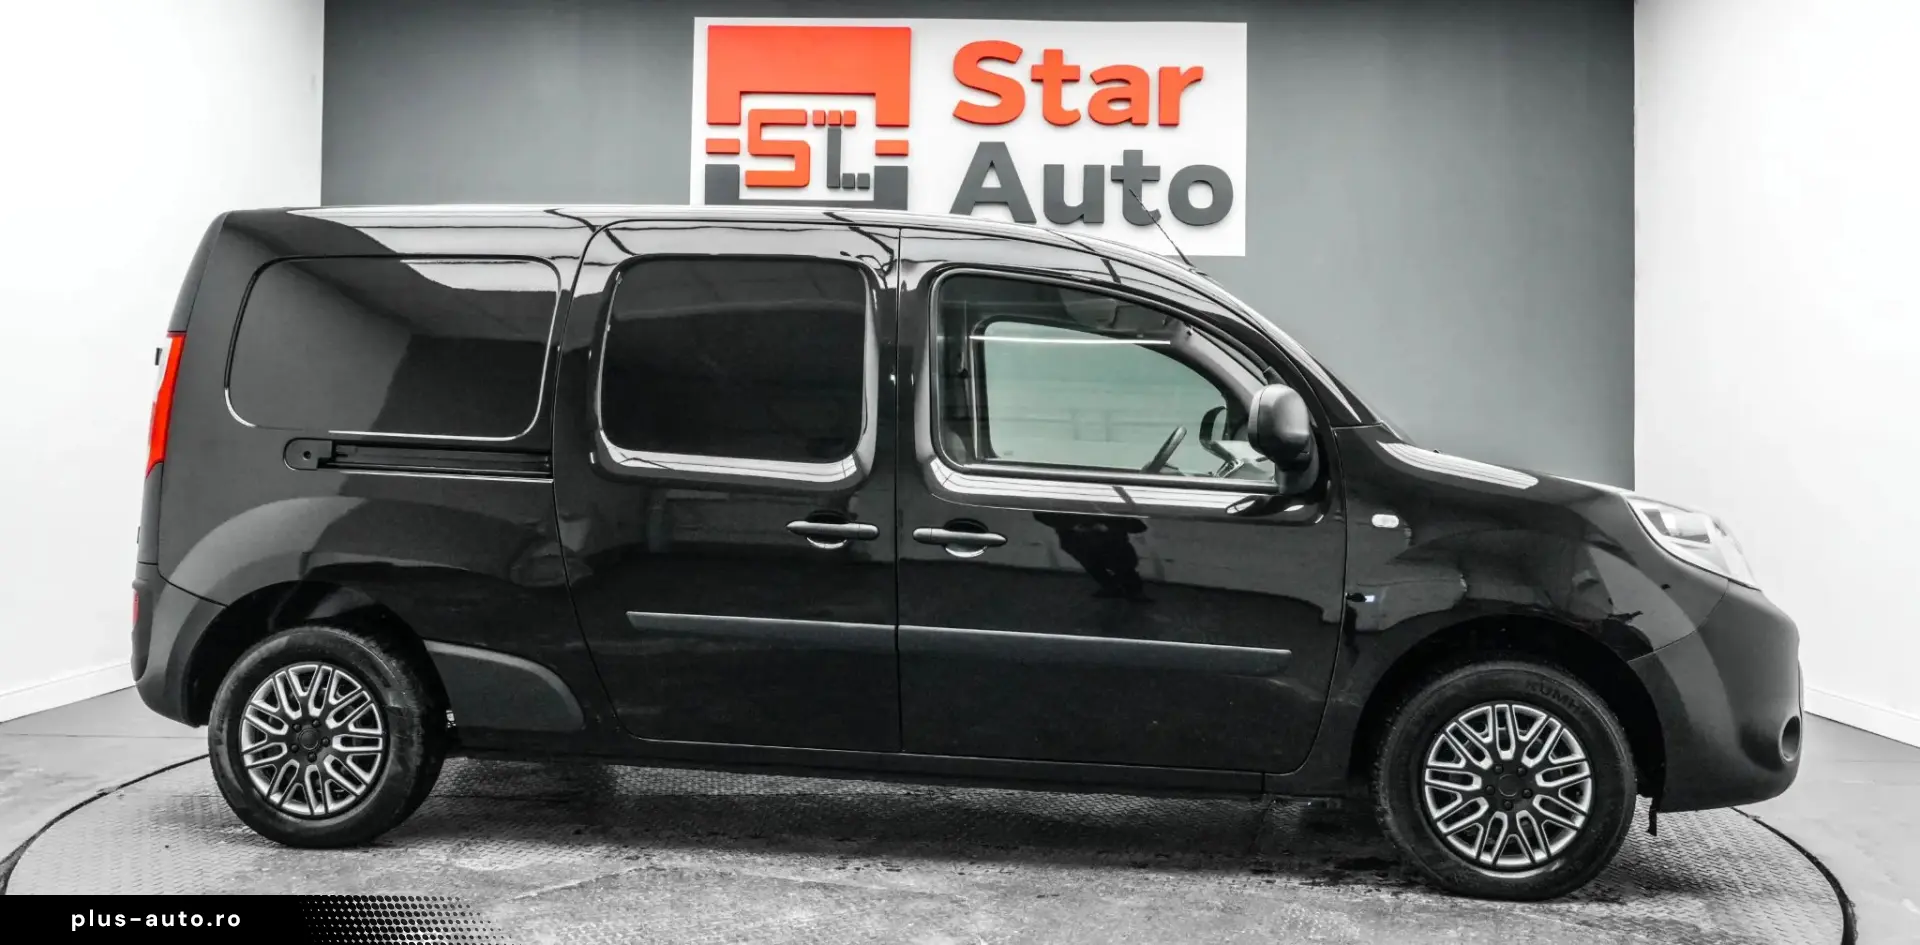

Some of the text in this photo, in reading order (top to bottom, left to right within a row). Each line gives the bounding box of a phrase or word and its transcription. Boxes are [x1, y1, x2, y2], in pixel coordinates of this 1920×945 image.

[953, 40, 1204, 127] Star
[949, 141, 1234, 226] Auto
[1525, 680, 1593, 722] KUMH
